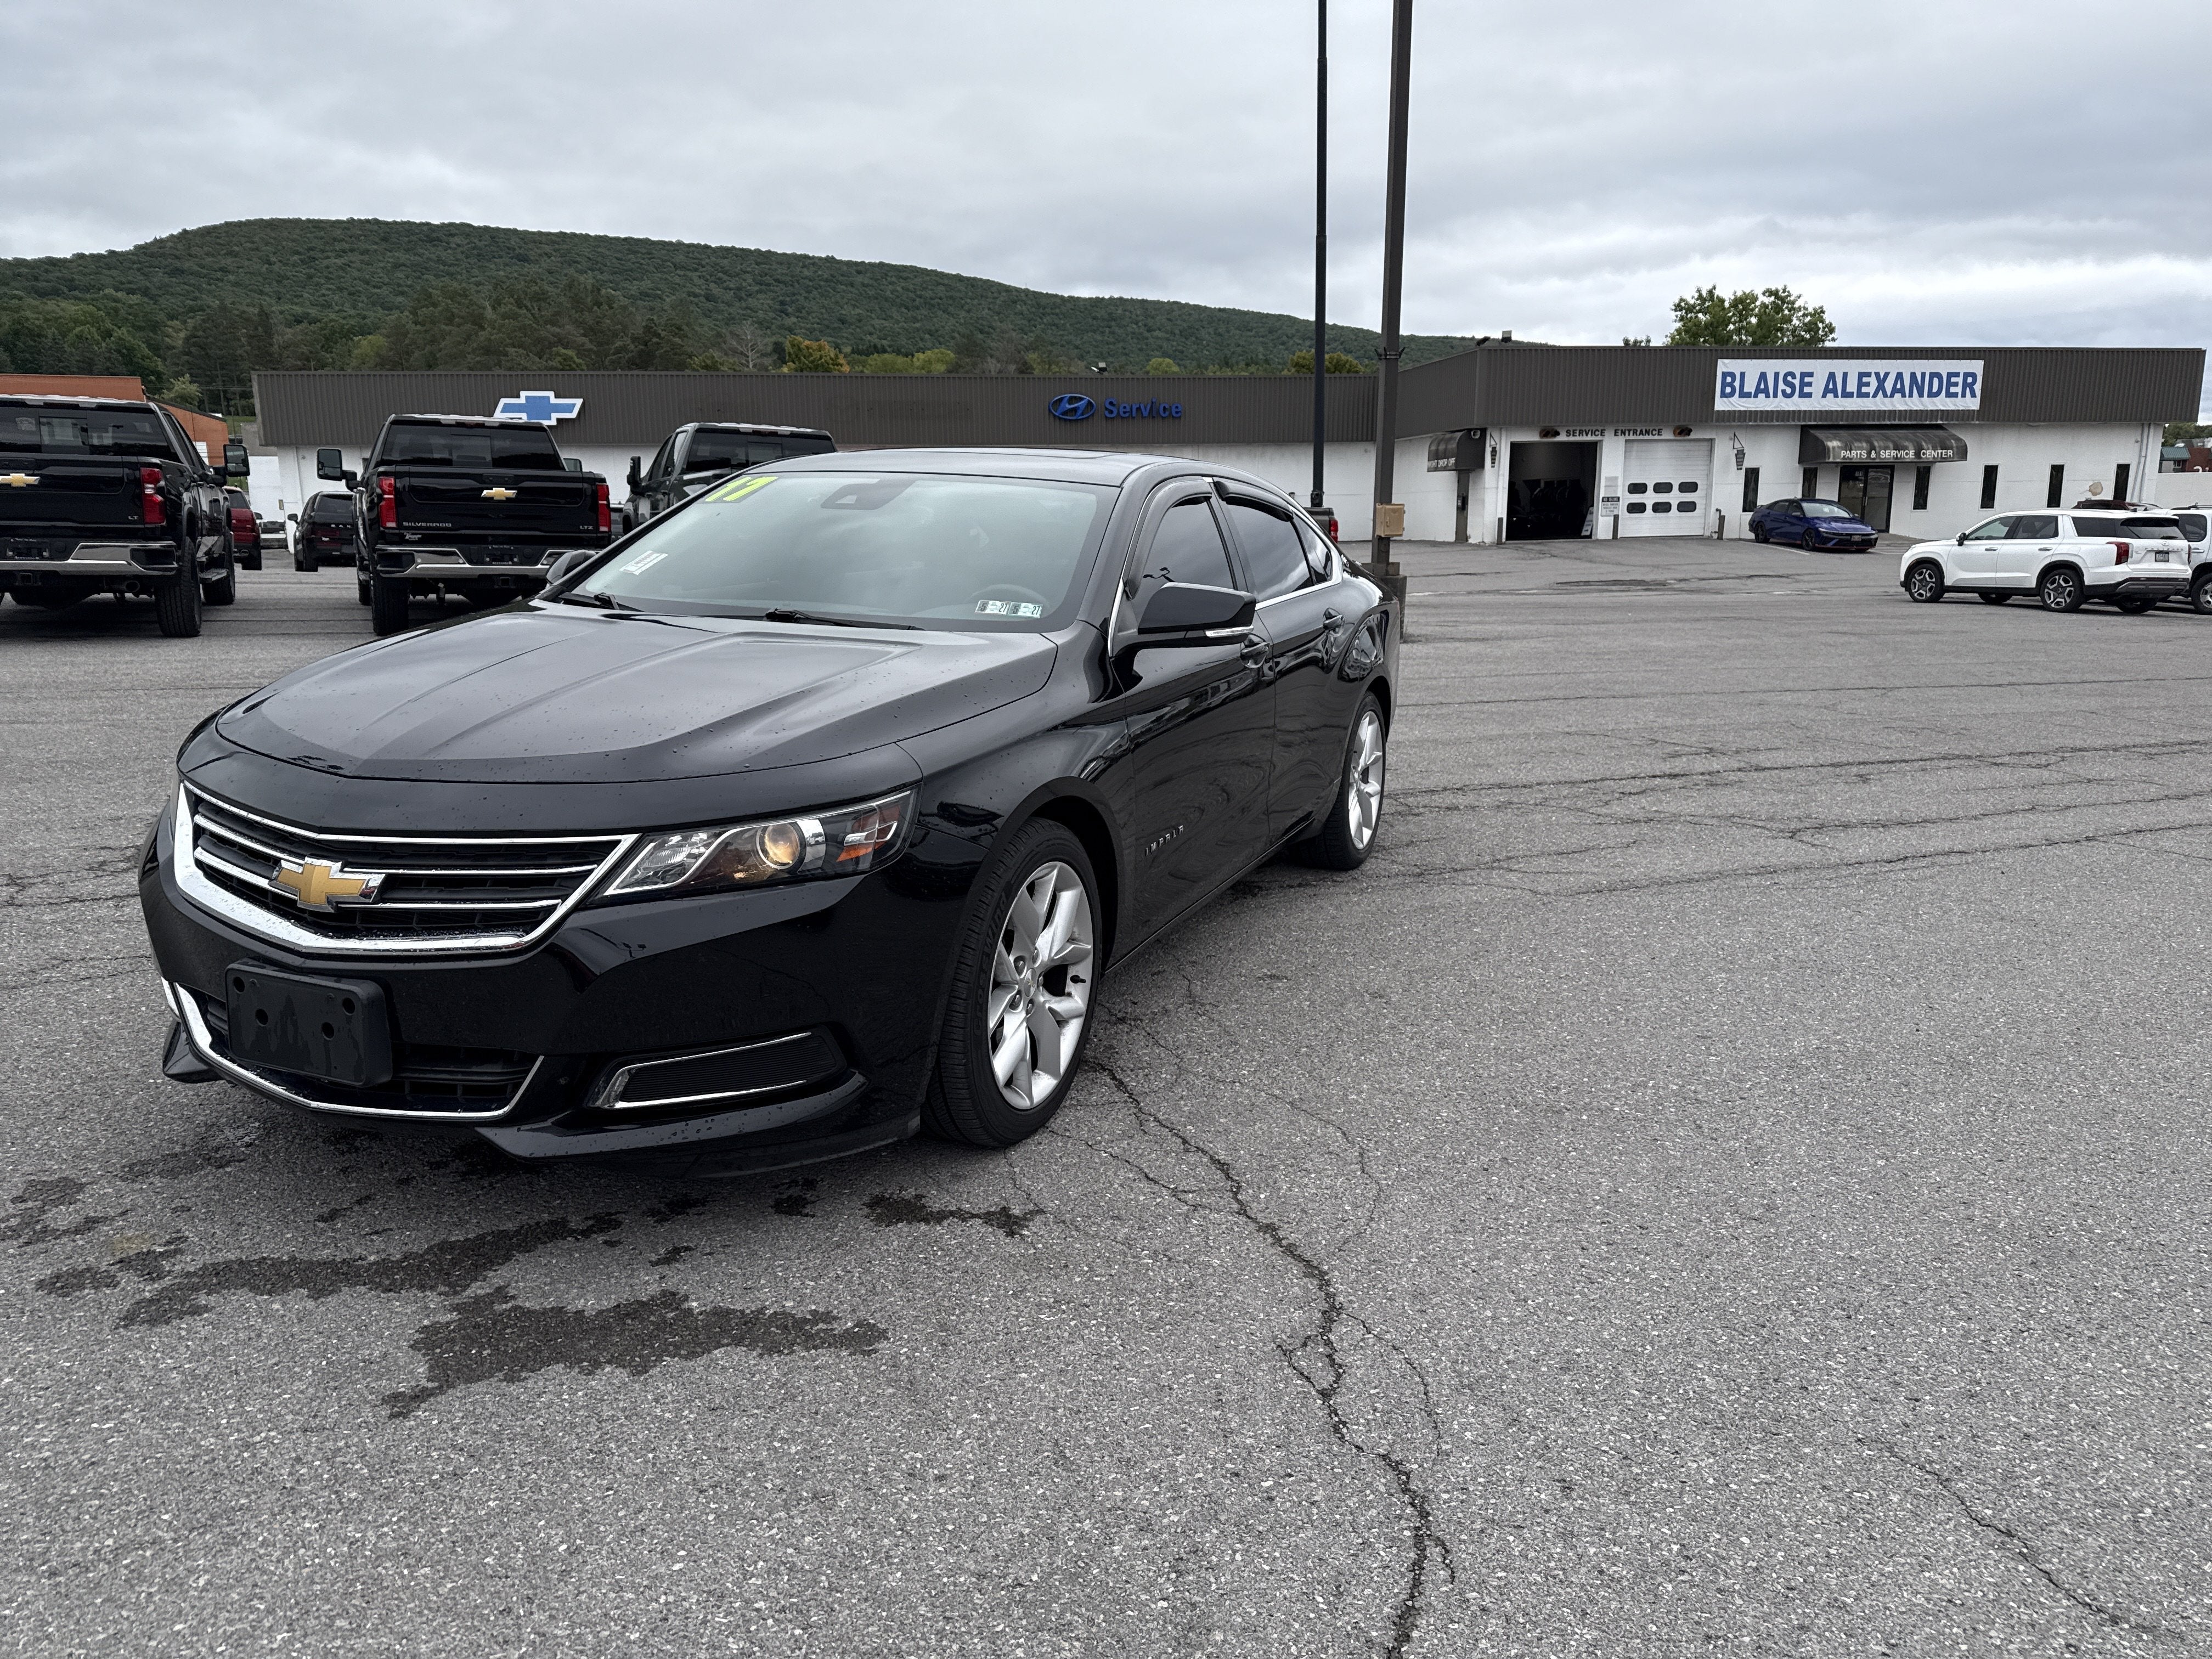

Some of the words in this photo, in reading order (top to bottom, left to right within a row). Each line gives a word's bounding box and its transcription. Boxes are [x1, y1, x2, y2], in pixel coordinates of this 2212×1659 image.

[1719, 371, 1814, 399] BLAISE
[1821, 371, 1978, 398] ALEXANDER
[1104, 397, 1183, 419] Service
[1565, 428, 1606, 437] SERVICE
[1613, 428, 1663, 437] ENTRANCE
[1841, 450, 1867, 459] PARTS
[1870, 450, 1876, 459] &
[1880, 450, 1915, 459] SERVICE
[1920, 449, 1953, 458] CENTER
[705, 476, 778, 502] 17
[998, 603, 1008, 613] 27
[1031, 605, 1041, 616] 27
[1145, 825, 1184, 856] IMPALA
